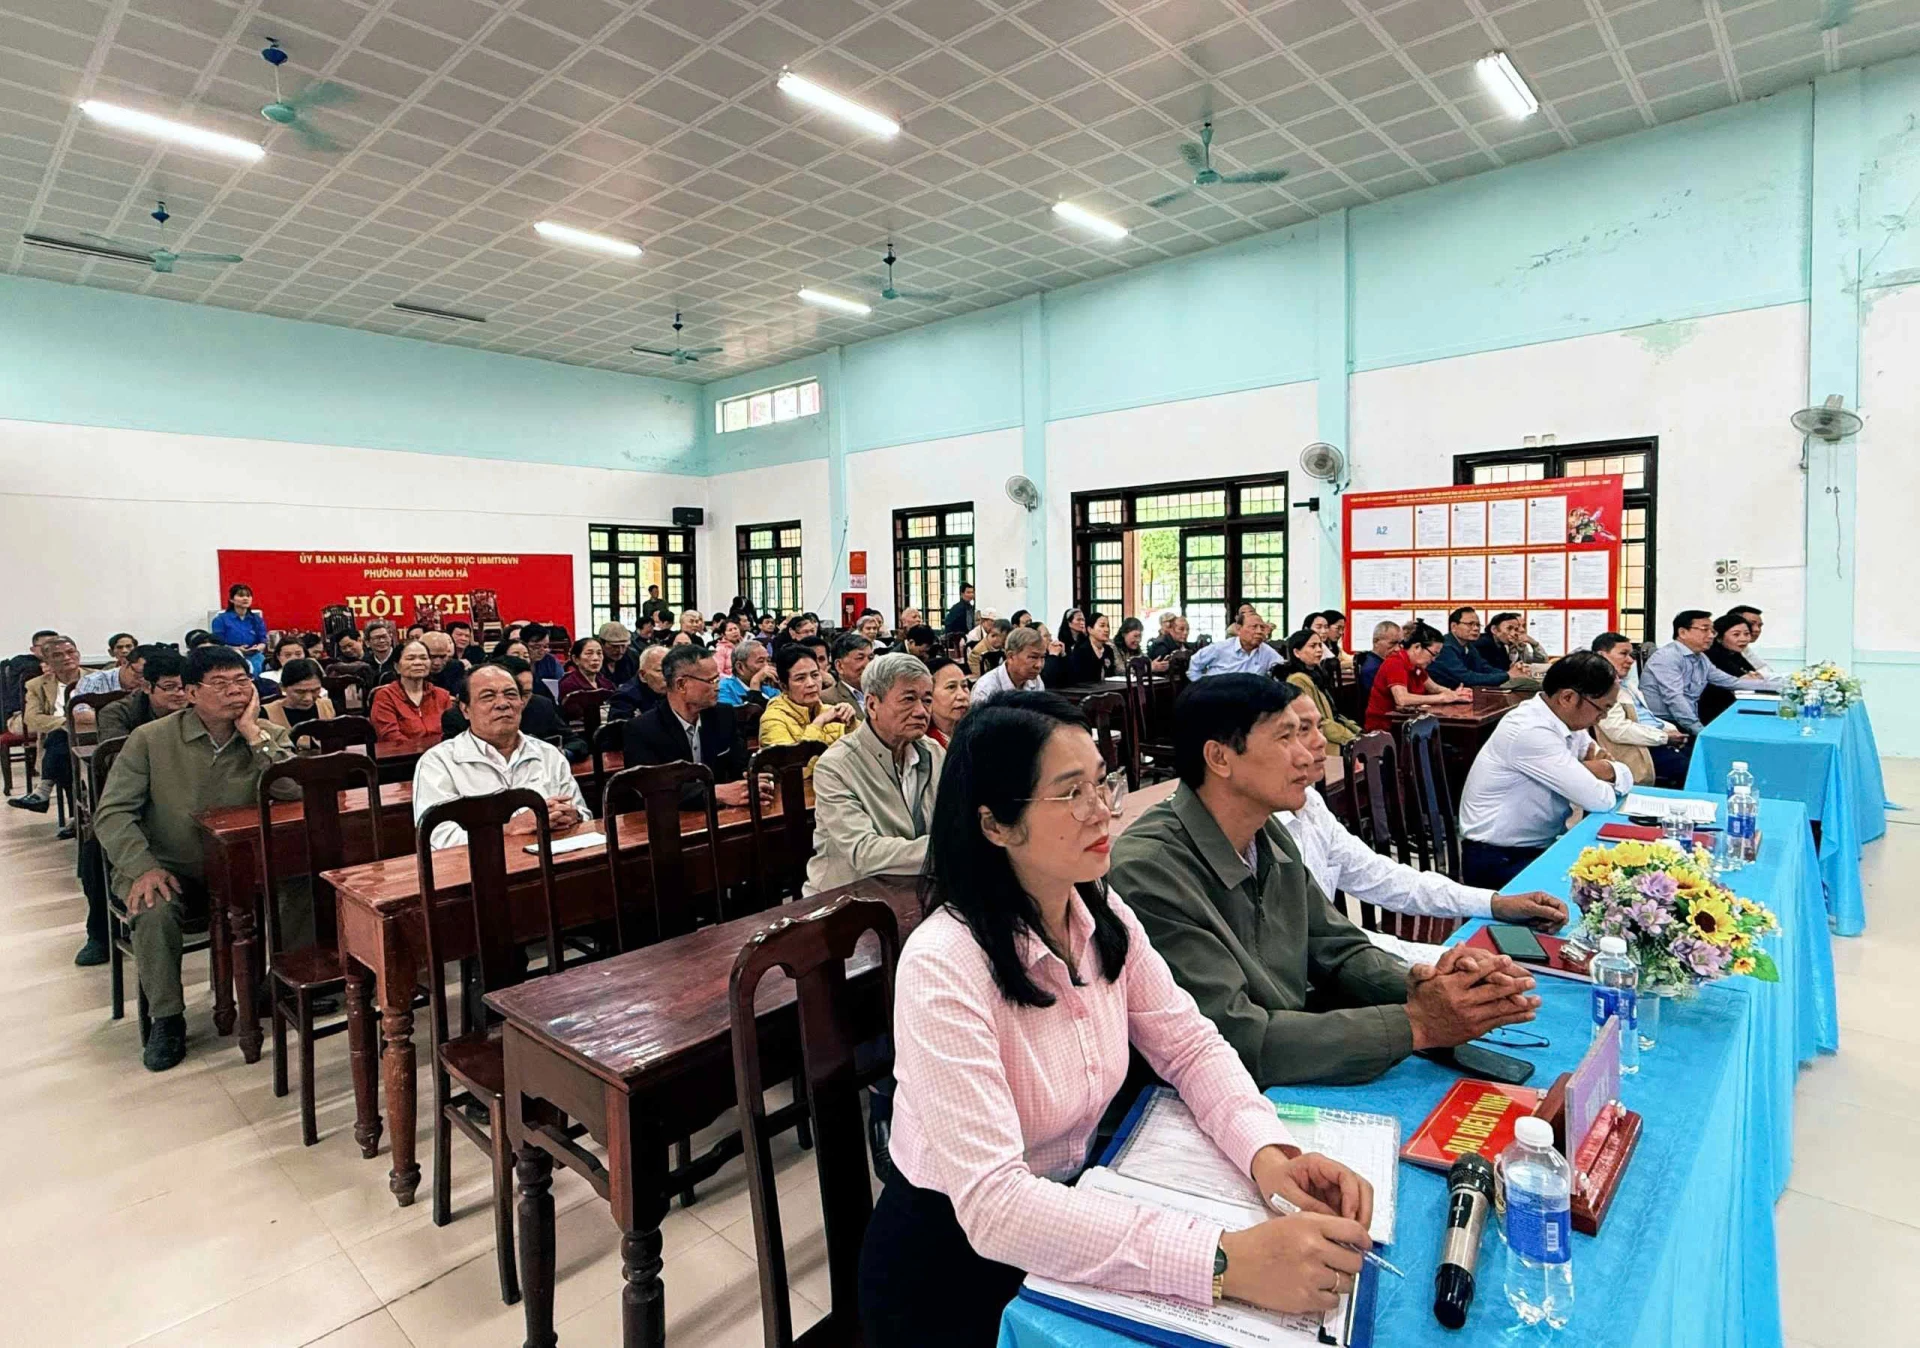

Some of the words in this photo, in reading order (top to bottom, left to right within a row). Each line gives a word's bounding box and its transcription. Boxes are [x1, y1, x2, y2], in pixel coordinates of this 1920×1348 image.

[1376, 526, 1388, 535] A2
[299, 552, 313, 564] ỦY
[315, 554, 336, 564] BAN
[338, 552, 366, 564] NHÂN
[395, 555, 414, 565] BAN
[416, 554, 453, 565] THƯỜNG
[454, 556, 475, 567] TRỰC
[476, 556, 519, 565] UBMTTQVN
[363, 567, 403, 578] PHƯỜNG
[405, 569, 426, 578] NAM
[456, 567, 468, 578] HÀ
[345, 589, 404, 620] HỘI
[413, 594, 472, 615] NGH
[1463, 1092, 1513, 1115] TỈNH
[1451, 1112, 1500, 1138] BIỂU
